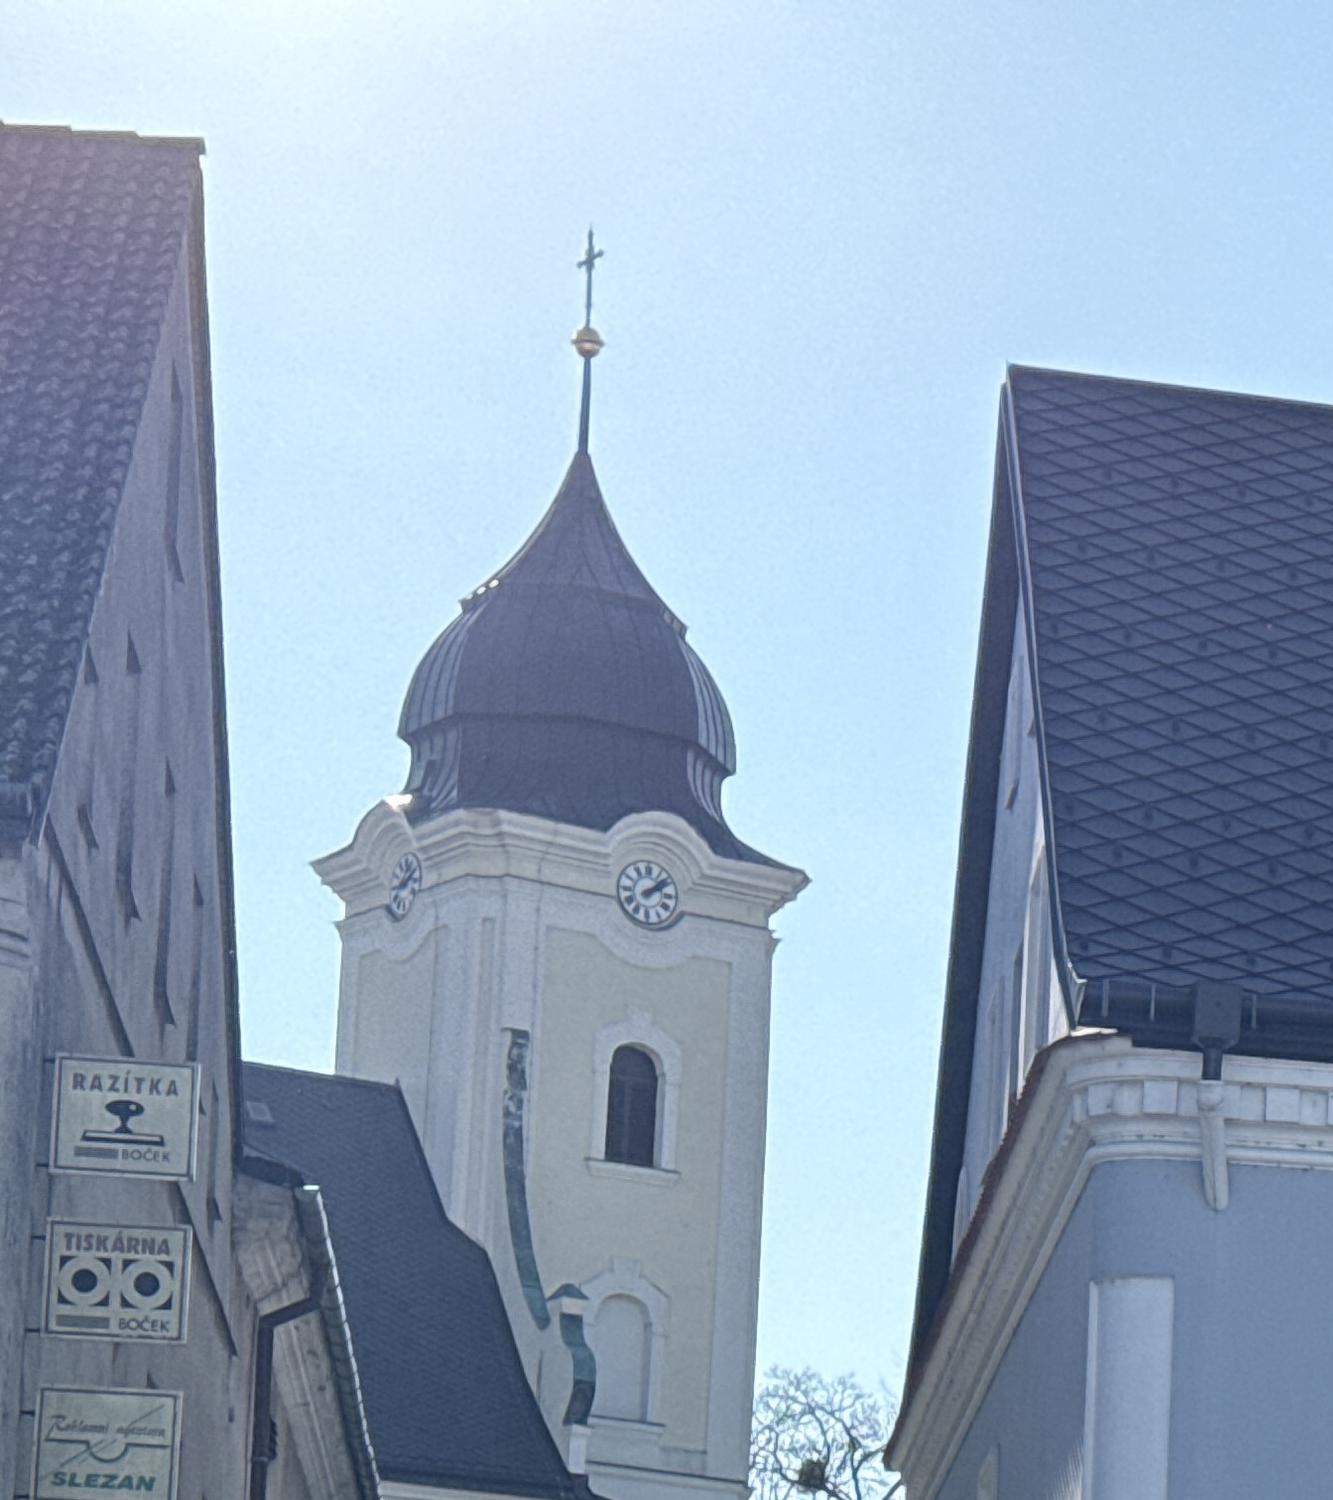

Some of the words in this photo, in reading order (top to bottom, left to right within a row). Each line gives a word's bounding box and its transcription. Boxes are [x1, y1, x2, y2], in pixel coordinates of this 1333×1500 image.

[72, 1069, 179, 1097] RAZÍTKA
[121, 1148, 170, 1163] BOČEK
[64, 1230, 170, 1256] TISKÁRNA
[119, 1315, 171, 1332] BOČEK
[50, 1471, 156, 1491] SLEZAN
